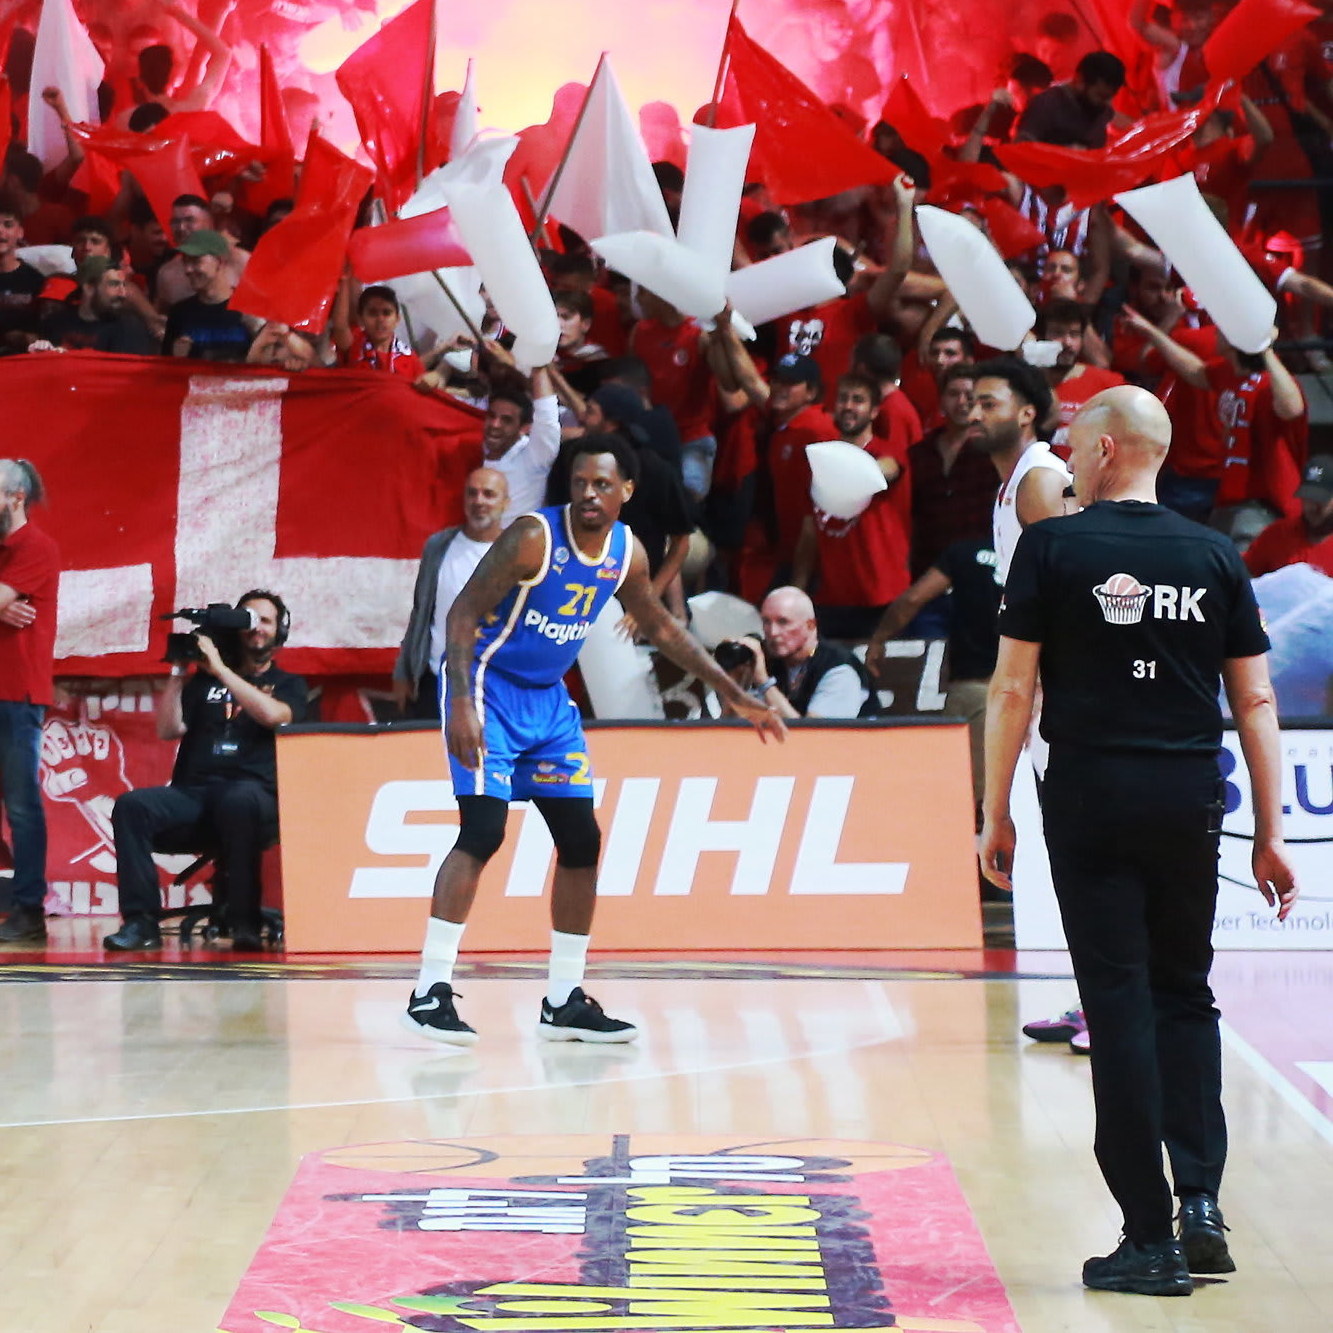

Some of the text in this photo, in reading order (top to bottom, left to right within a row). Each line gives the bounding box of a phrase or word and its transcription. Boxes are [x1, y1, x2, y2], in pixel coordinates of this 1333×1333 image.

[557, 583, 598, 617] 21
[1153, 586, 1207, 623] RK
[1133, 660, 1156, 679] 31
[348, 775, 909, 898] STIHL
